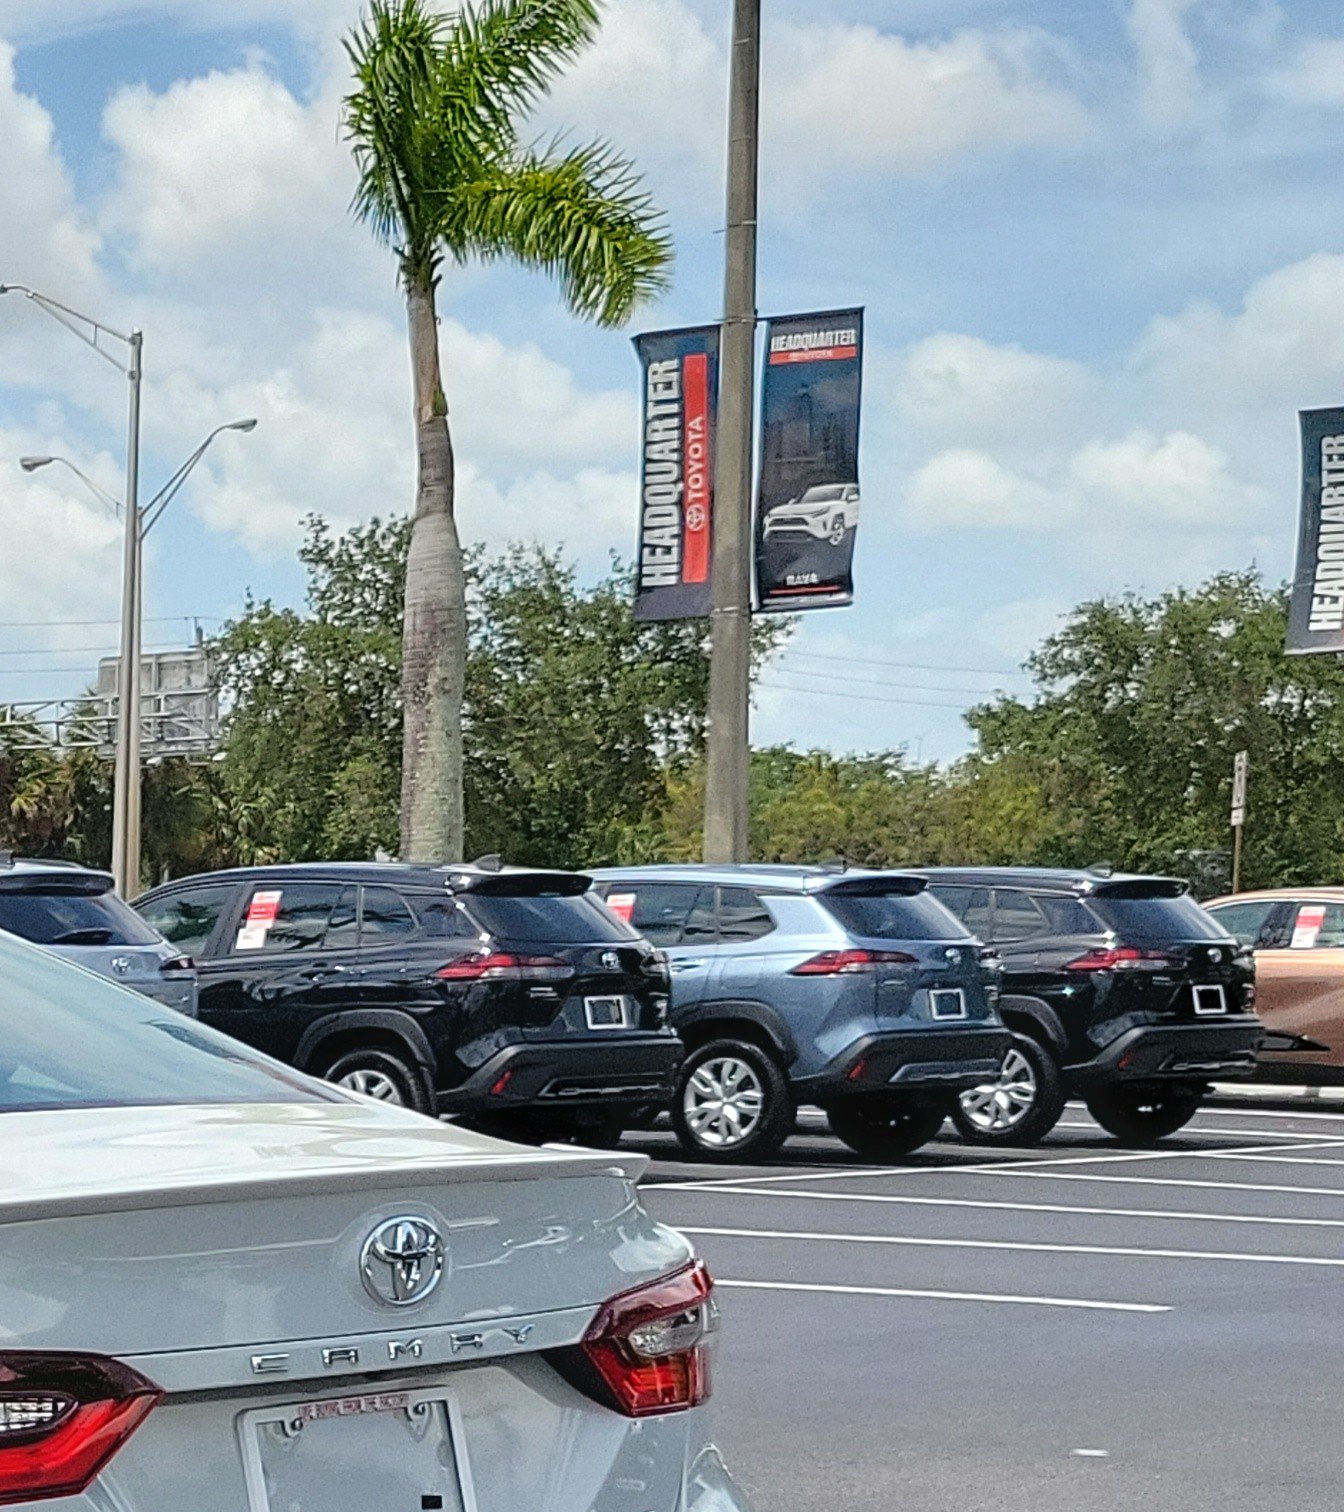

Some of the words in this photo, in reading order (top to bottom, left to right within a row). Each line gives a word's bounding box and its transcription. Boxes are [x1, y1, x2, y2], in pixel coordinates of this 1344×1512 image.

[770, 329, 857, 352] HEADQUARTER
[641, 357, 684, 587] HEADQUARTER
[688, 416, 704, 501] TOYOTA
[250, 1323, 535, 1375] CAMRY
